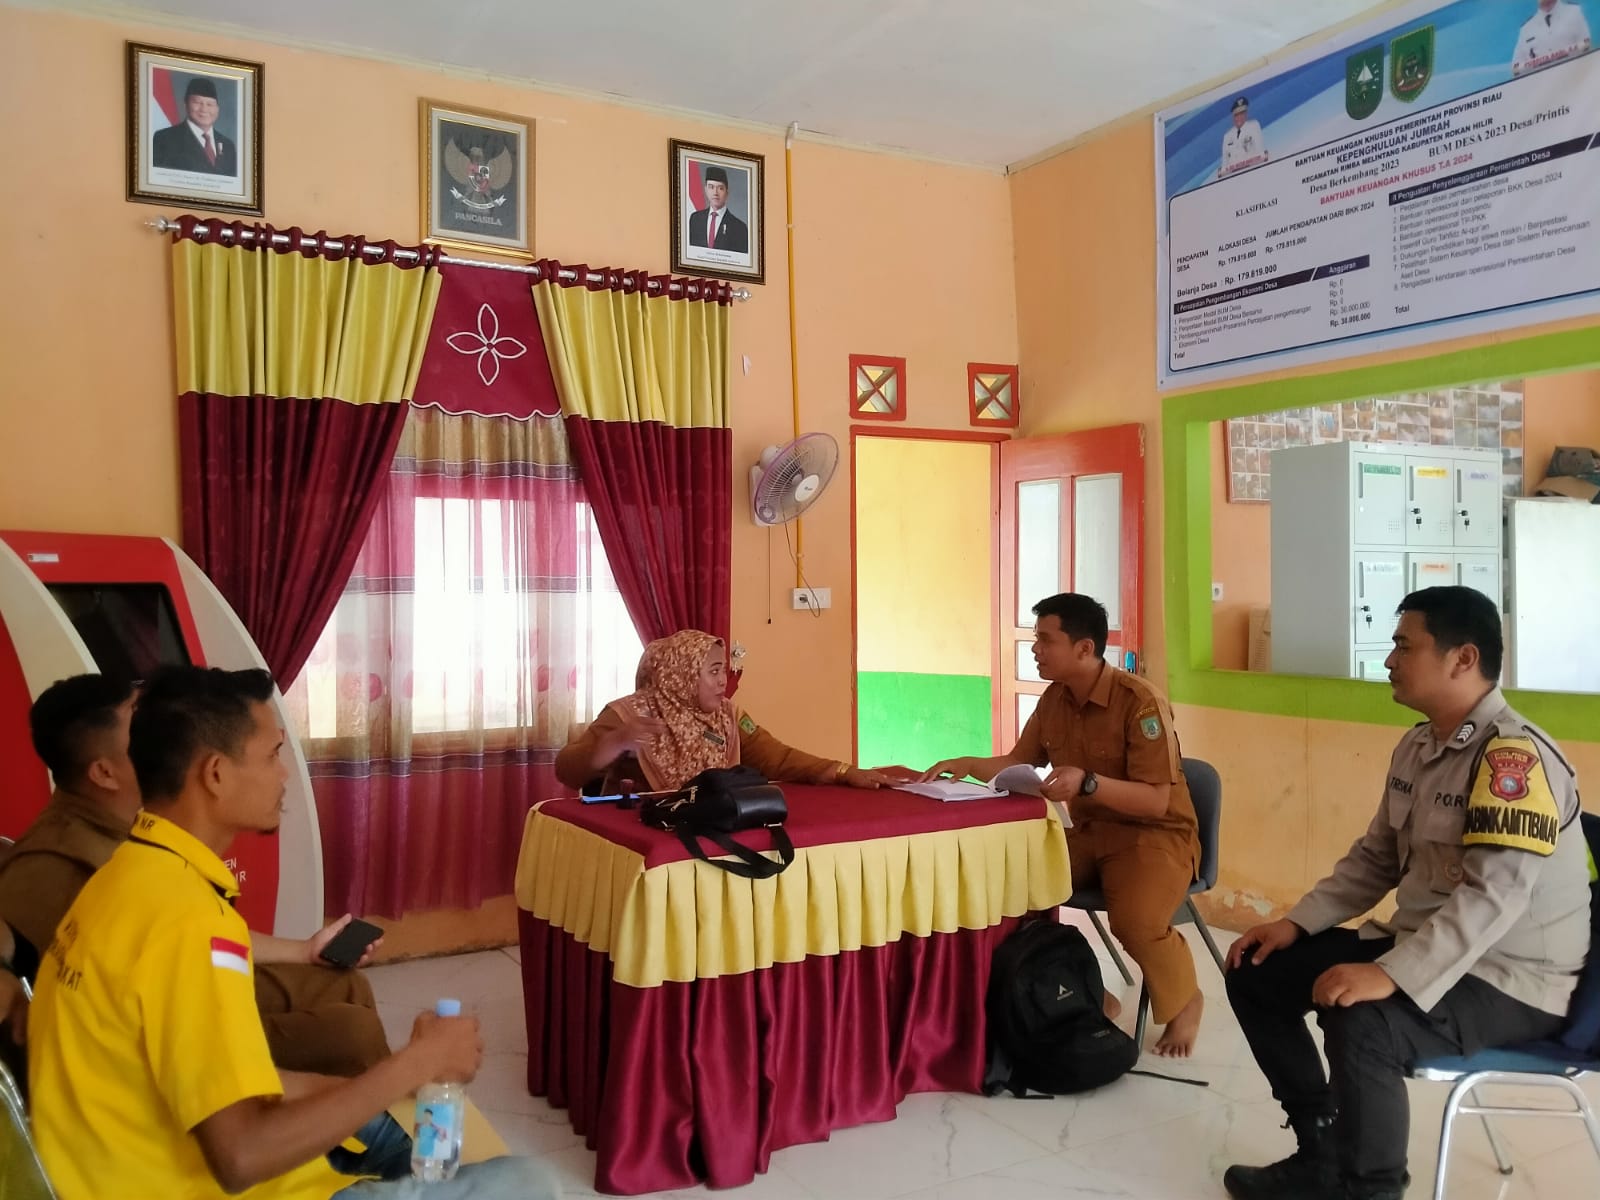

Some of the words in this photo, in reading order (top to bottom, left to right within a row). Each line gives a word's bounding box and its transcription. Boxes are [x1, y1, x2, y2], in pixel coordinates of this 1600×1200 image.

[1296, 152, 1325, 167] BANTUAN
[1326, 140, 1362, 156] KEUANGAN
[1365, 129, 1393, 143] KHUSUS
[1395, 112, 1442, 134] PEMERINTAH
[1444, 100, 1480, 117] PROVINSI
[1482, 92, 1502, 104] RIAU
[1302, 167, 1338, 184] KECAMATAN
[1340, 161, 1360, 172] RIMBA
[1362, 148, 1400, 165] MELINTANG
[1402, 135, 1442, 152] KABUPATEN
[1445, 126, 1470, 139] ROKAN
[1473, 118, 1493, 130] HILIR
[1337, 134, 1407, 164] KEPENGHULUAN
[1410, 120, 1450, 140] JUMRAH
[1429, 142, 1452, 157] BUM
[1456, 136, 1482, 150] DESA
[1486, 126, 1506, 140] 2023
[1490, 156, 1529, 173] Pemerintah
[1532, 151, 1550, 161] Desa
[1310, 184, 1327, 194] Desa
[1330, 166, 1378, 188] Berkembang
[1381, 159, 1400, 172] 2023
[1320, 188, 1354, 205] BANTUAN
[1357, 175, 1400, 194] KEUANGAN
[1402, 163, 1436, 180] KHUSUS
[1454, 153, 1472, 165] 2024
[1508, 183, 1523, 192] BKK
[1525, 178, 1543, 188] Desa
[1544, 172, 1562, 183] 2024
[1236, 198, 1278, 218] KLASIFIKASI
[456, 212, 502, 226] PANCASILA
[1266, 226, 1288, 239] JUMLAH
[1290, 214, 1327, 231] PENDAPATAN
[1329, 210, 1344, 220] DARI
[1346, 206, 1359, 216] BKK
[1361, 201, 1374, 211] 2024
[1218, 240, 1241, 252] ALOKASI
[1242, 236, 1256, 245] DESA
[1557, 246, 1576, 256] Desa
[1177, 249, 1208, 264] PENDAPATAN
[1177, 264, 1190, 272] DESA
[1177, 286, 1199, 297] Belanja
[1201, 282, 1217, 291] Desa
[1395, 304, 1409, 314] Total
